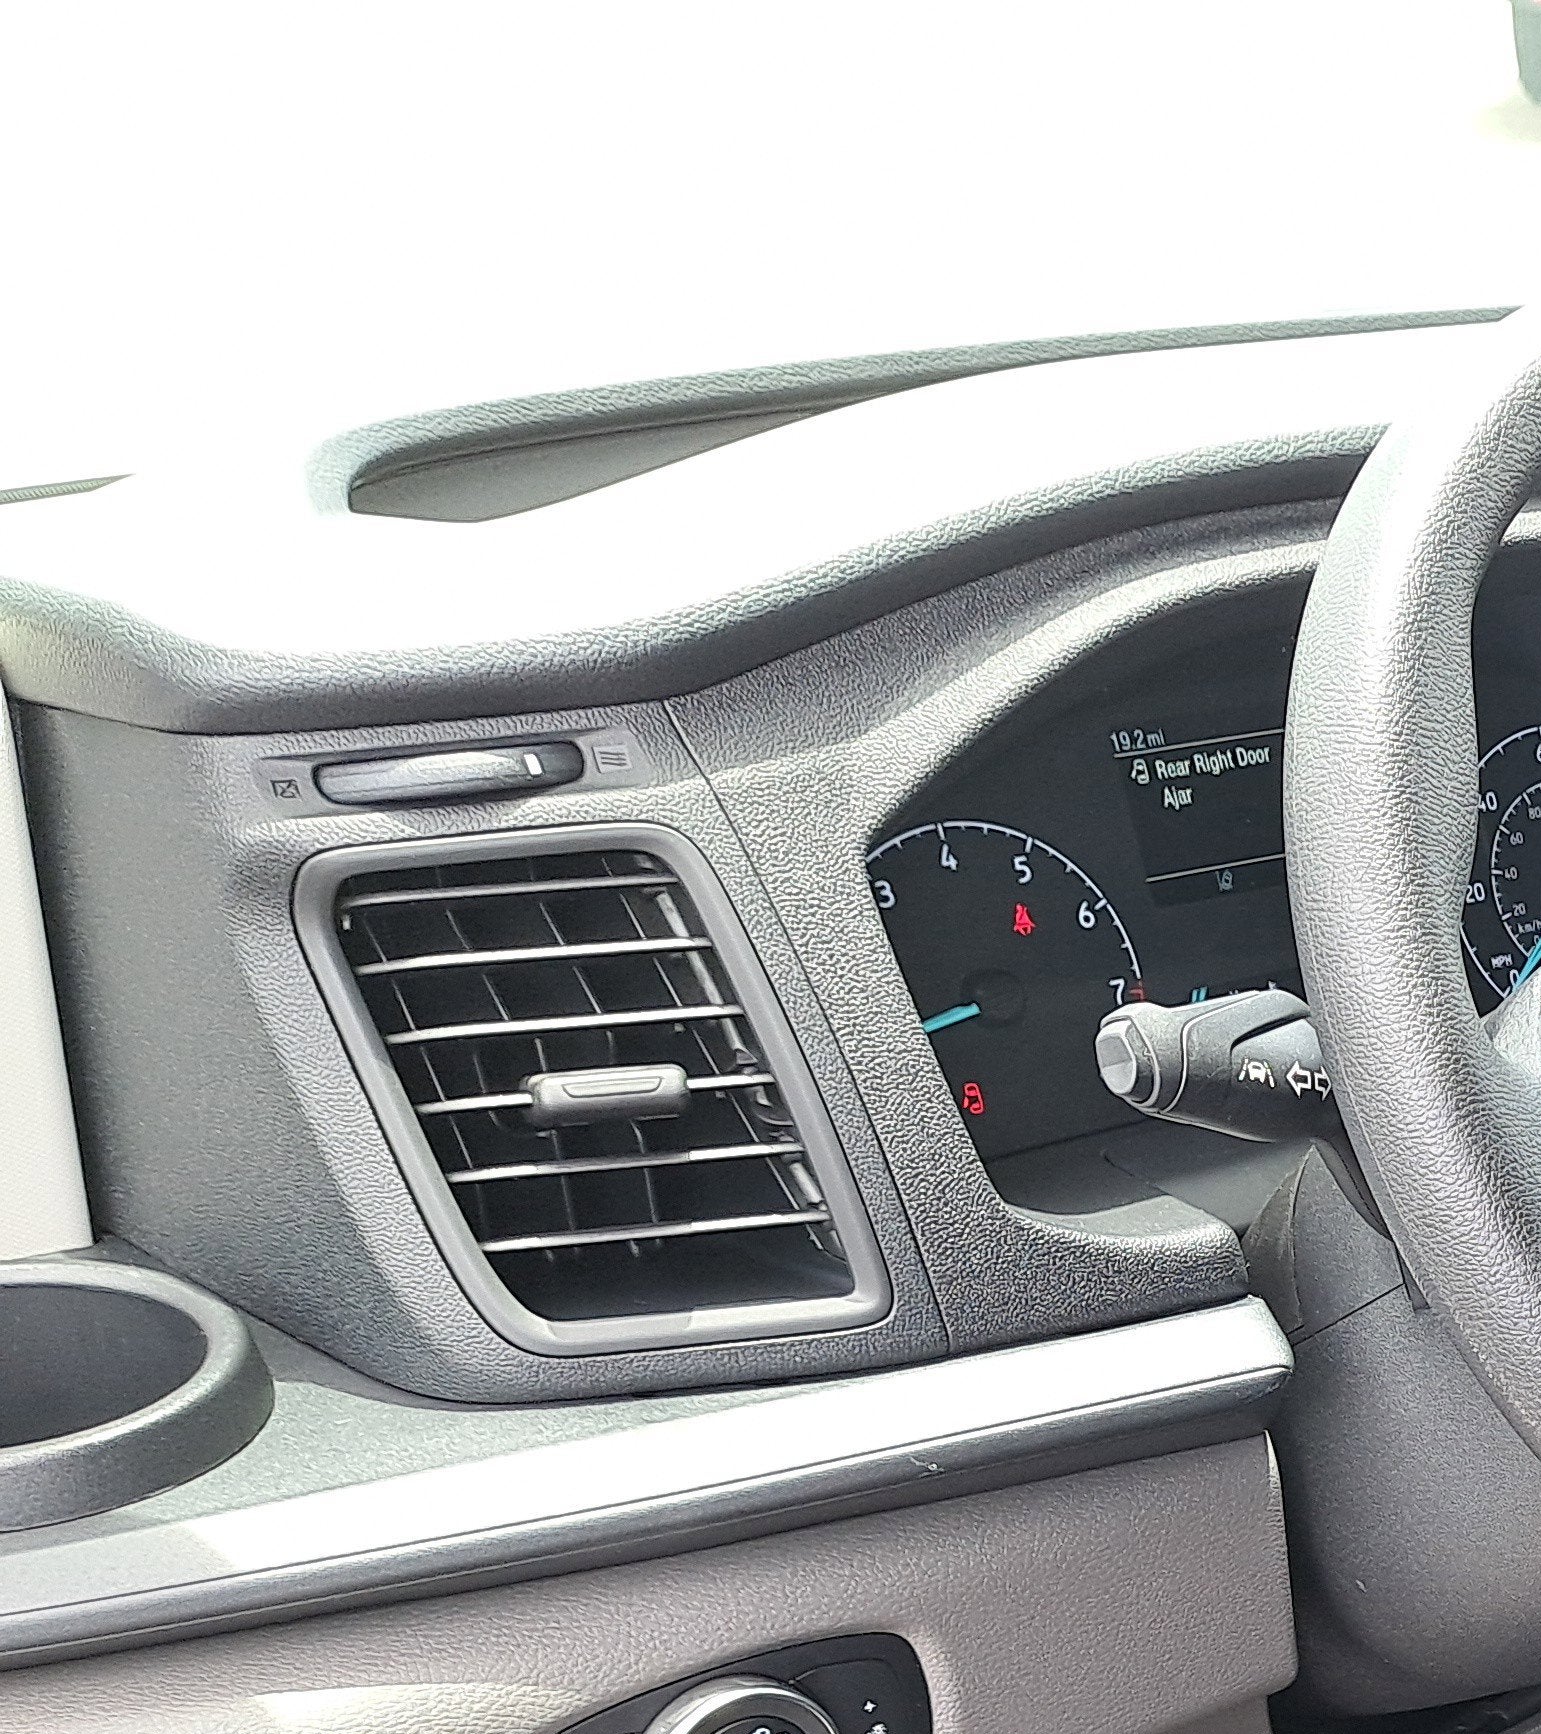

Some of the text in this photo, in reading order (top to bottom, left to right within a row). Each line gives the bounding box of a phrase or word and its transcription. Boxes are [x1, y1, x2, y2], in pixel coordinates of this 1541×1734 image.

[1154, 745, 1271, 781] Rear Right Door
[1162, 785, 1193, 812] Ajar
[1509, 832, 1524, 846] 60
[939, 843, 959, 872] 4
[1011, 853, 1034, 885] 5
[1503, 867, 1518, 880] 40
[873, 879, 897, 910] 3
[1077, 899, 1097, 930] 6
[1511, 902, 1527, 917] 20
[1490, 953, 1513, 970] MPH
[1108, 977, 1126, 1006] 7
